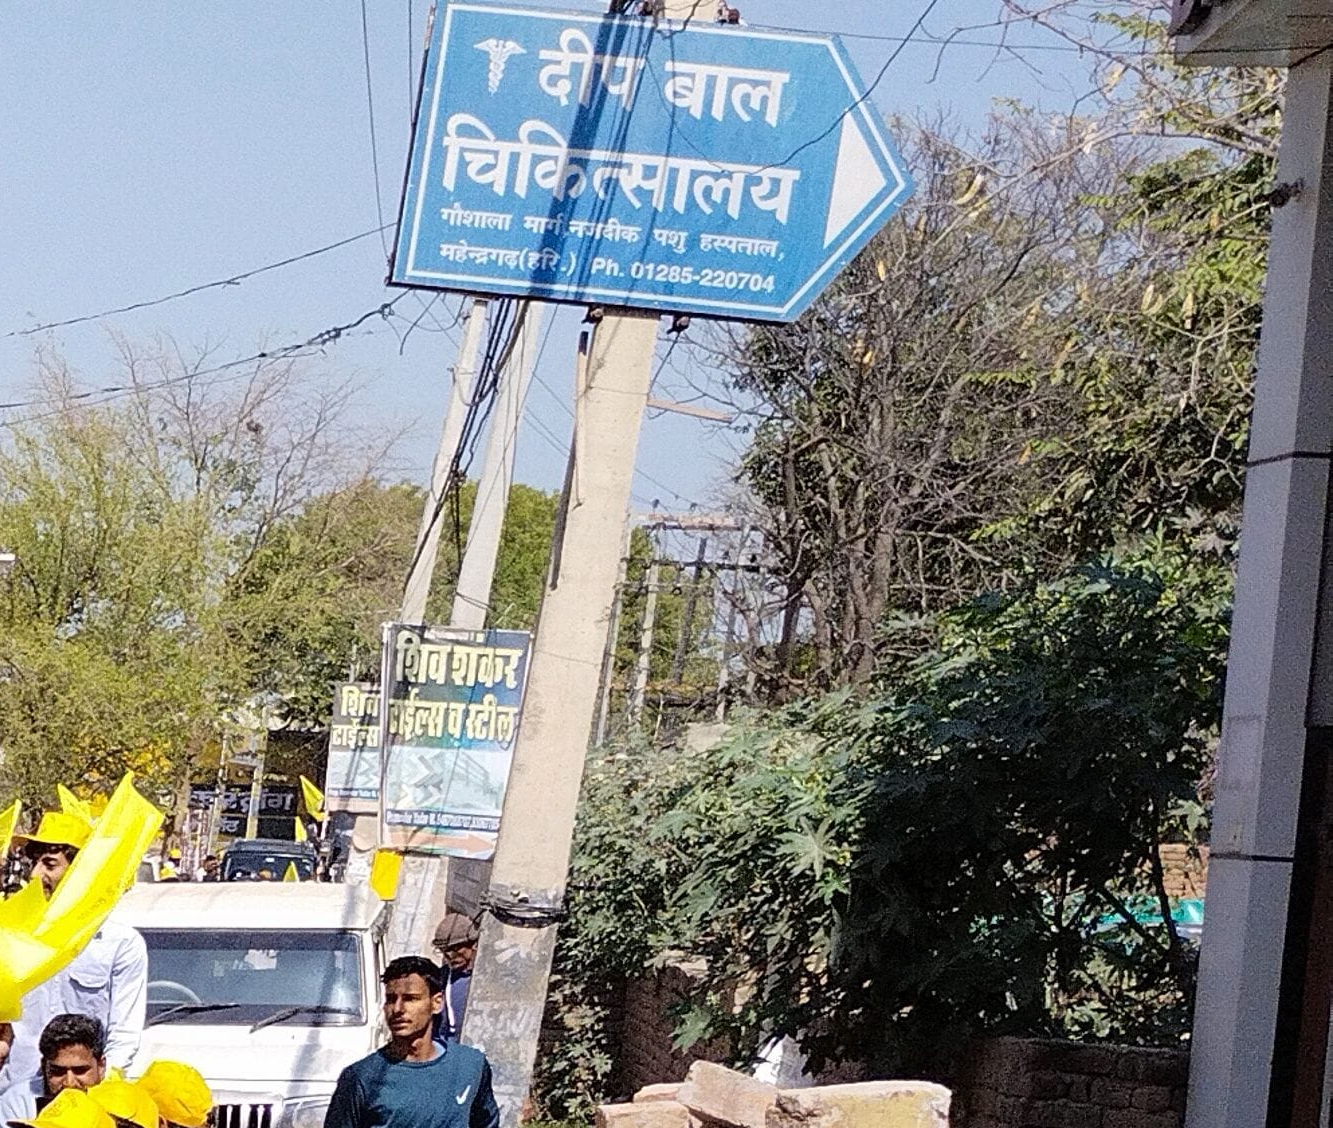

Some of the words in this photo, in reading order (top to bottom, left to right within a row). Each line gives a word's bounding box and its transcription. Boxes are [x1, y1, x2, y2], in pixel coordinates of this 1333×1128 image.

[538, 28, 645, 111] दीप
[664, 60, 790, 128] बाल
[441, 113, 800, 226] चिकित्सालय
[653, 226, 687, 256] पशु
[590, 258, 624, 279] Ph.
[630, 265, 775, 294] 01285-220704
[395, 631, 451, 685] शिव
[340, 684, 380, 717] शिव
[447, 701, 465, 739] व
[465, 694, 520, 742] स्टील
